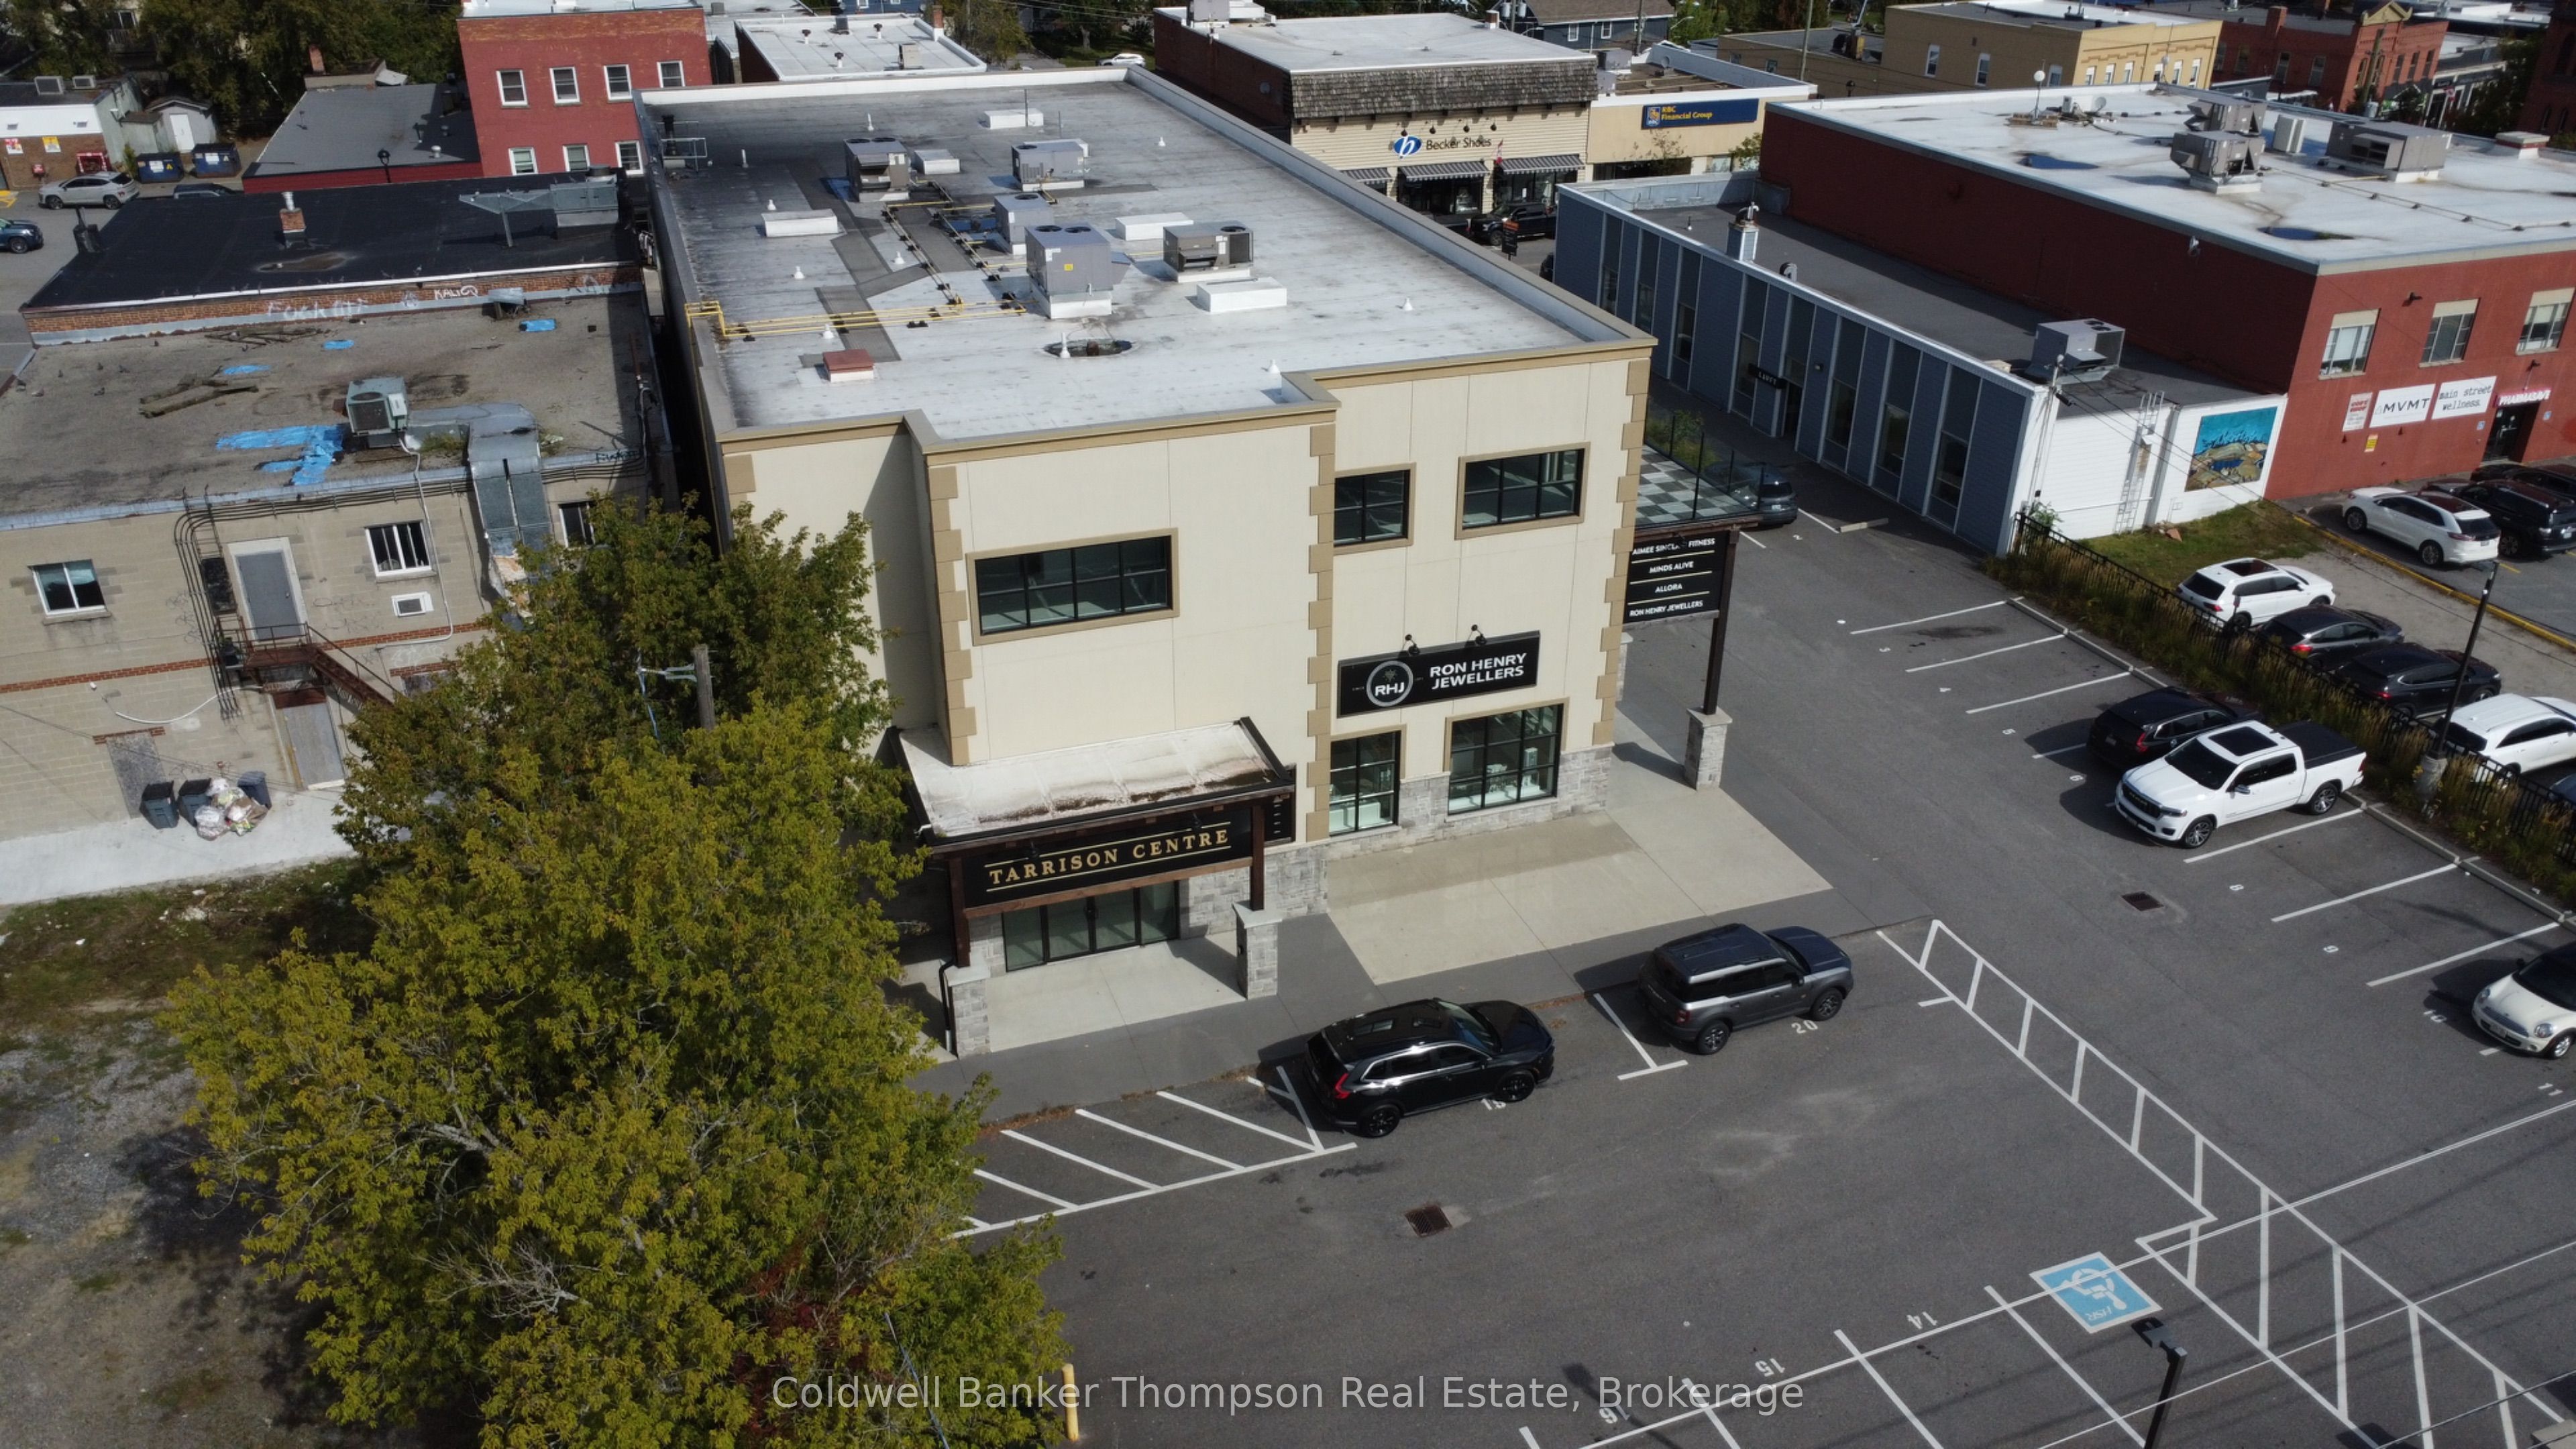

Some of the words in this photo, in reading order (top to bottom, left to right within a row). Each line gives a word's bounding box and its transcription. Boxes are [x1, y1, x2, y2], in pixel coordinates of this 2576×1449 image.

[1661, 111, 1691, 120] Financial
[1692, 111, 1713, 119] Group
[1426, 138, 1460, 150] Becker
[1463, 137, 1492, 148] Shoes
[2439, 390, 2458, 400] main
[2463, 385, 2491, 397] street
[2382, 397, 2430, 414] MVMT
[1631, 545, 1654, 555] AIMEE
[1655, 543, 1684, 552] SINCLA
[1688, 538, 1715, 548] FITNESS
[1649, 564, 1672, 574] MINDS
[1673, 561, 1695, 570] ALIVE
[1654, 583, 1682, 593] ALLORA
[1644, 606, 1667, 615] HENRY
[1667, 600, 1703, 612] JEWELLERS
[1430, 661, 1467, 678] RON
[1471, 652, 1527, 671] HENRY
[1432, 665, 1524, 690] JEWELLERS
[1375, 682, 1405, 696] RHJ
[989, 848, 1118, 885] TARRISON
[1132, 828, 1229, 859] CENTRE
[2423, 1010, 2447, 1023] 10
[1791, 1020, 1818, 1034] 20
[1907, 1311, 1938, 1330] 14
[1755, 1357, 1786, 1377] 15
